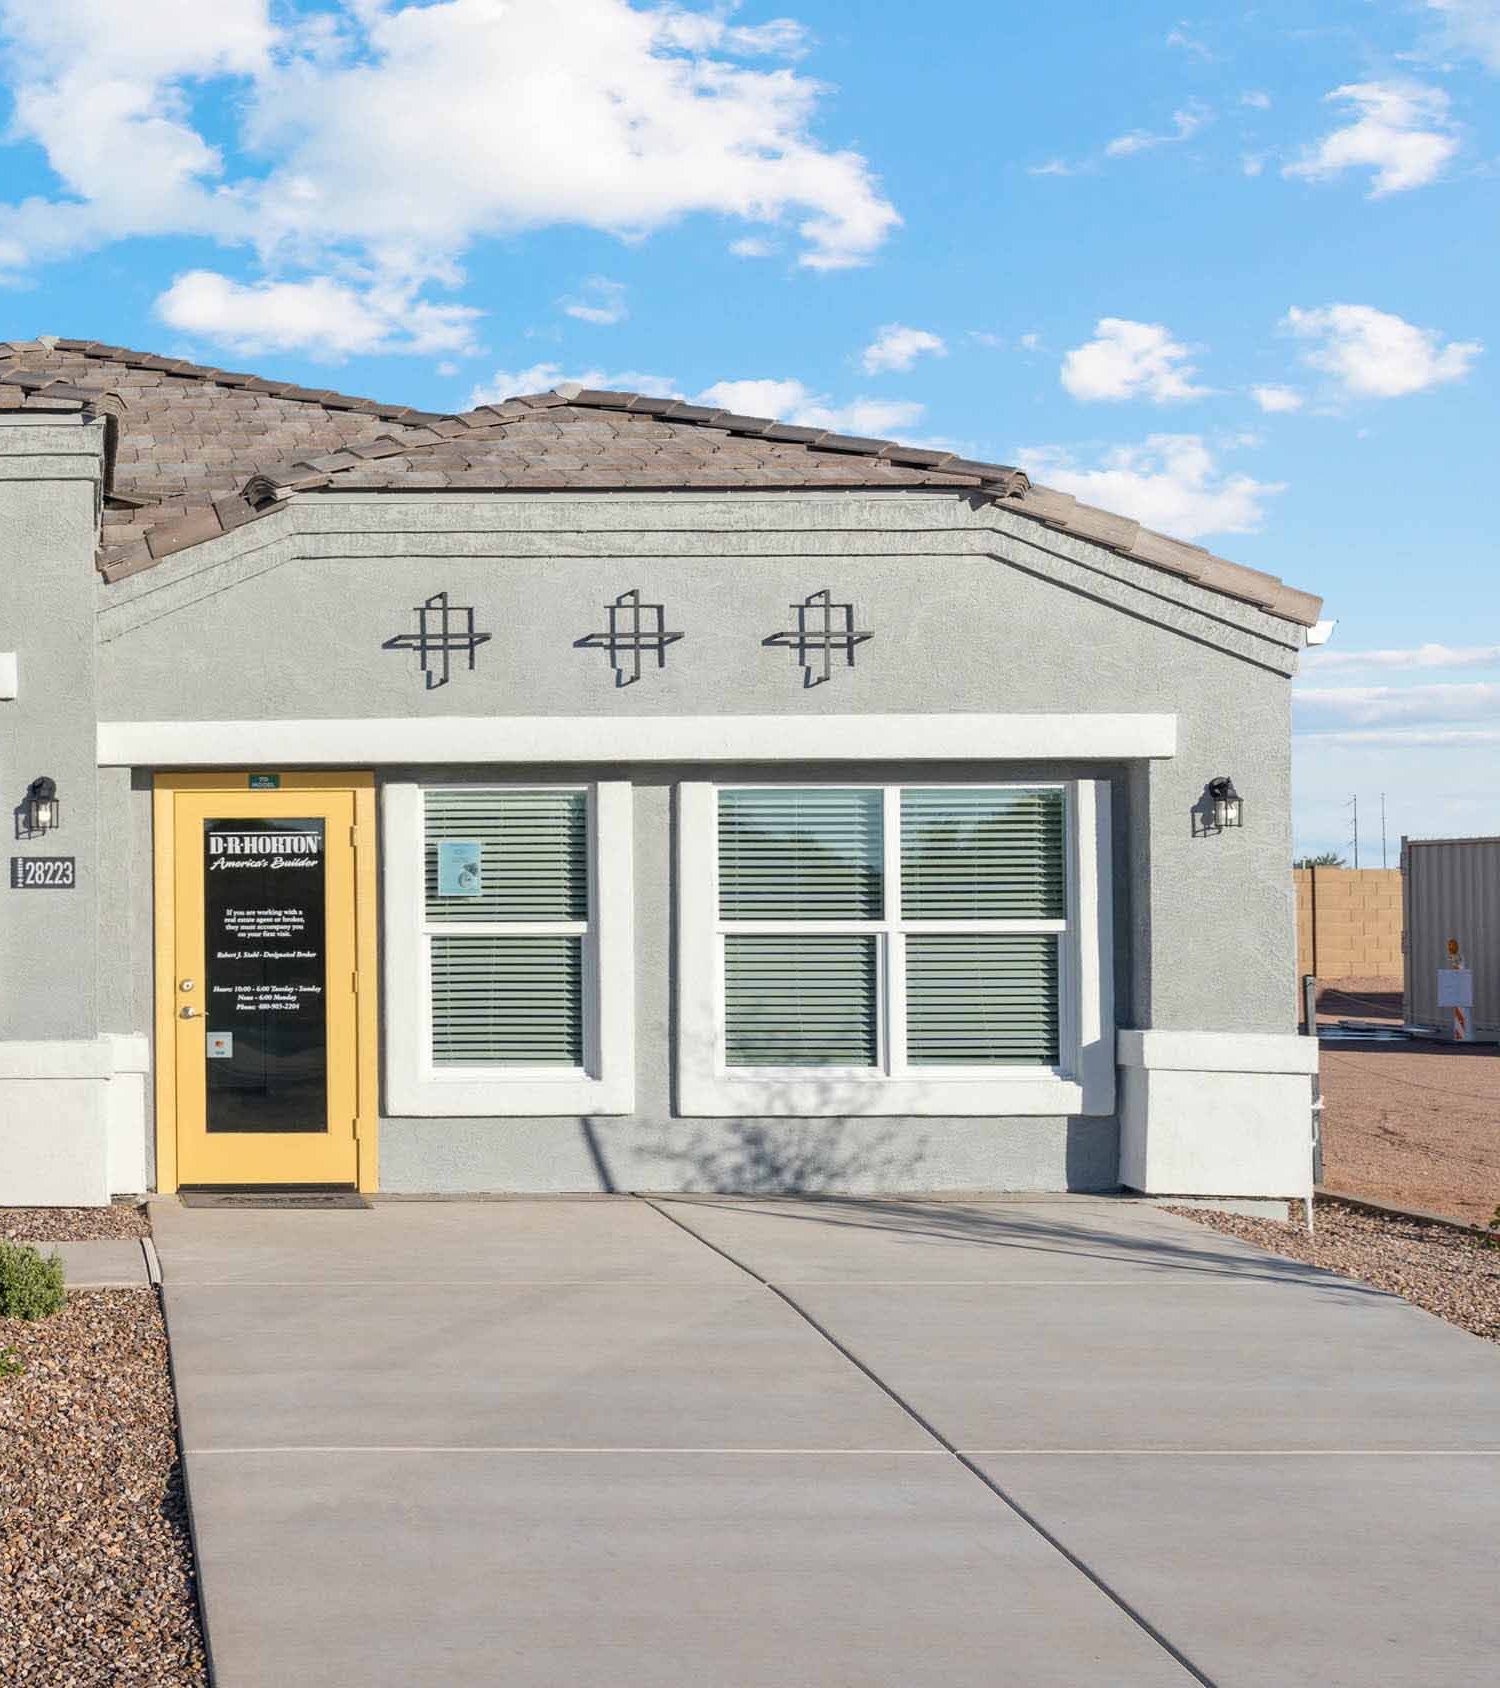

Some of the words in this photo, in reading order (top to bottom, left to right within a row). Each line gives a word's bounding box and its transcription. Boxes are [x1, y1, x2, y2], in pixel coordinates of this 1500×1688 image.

[210, 857, 268, 870] America's
[270, 856, 319, 869] Builder
[25, 861, 73, 884] 28223
[256, 909, 282, 917] working
[263, 951, 296, 959] Designated
[299, 985, 321, 994] Sunday
